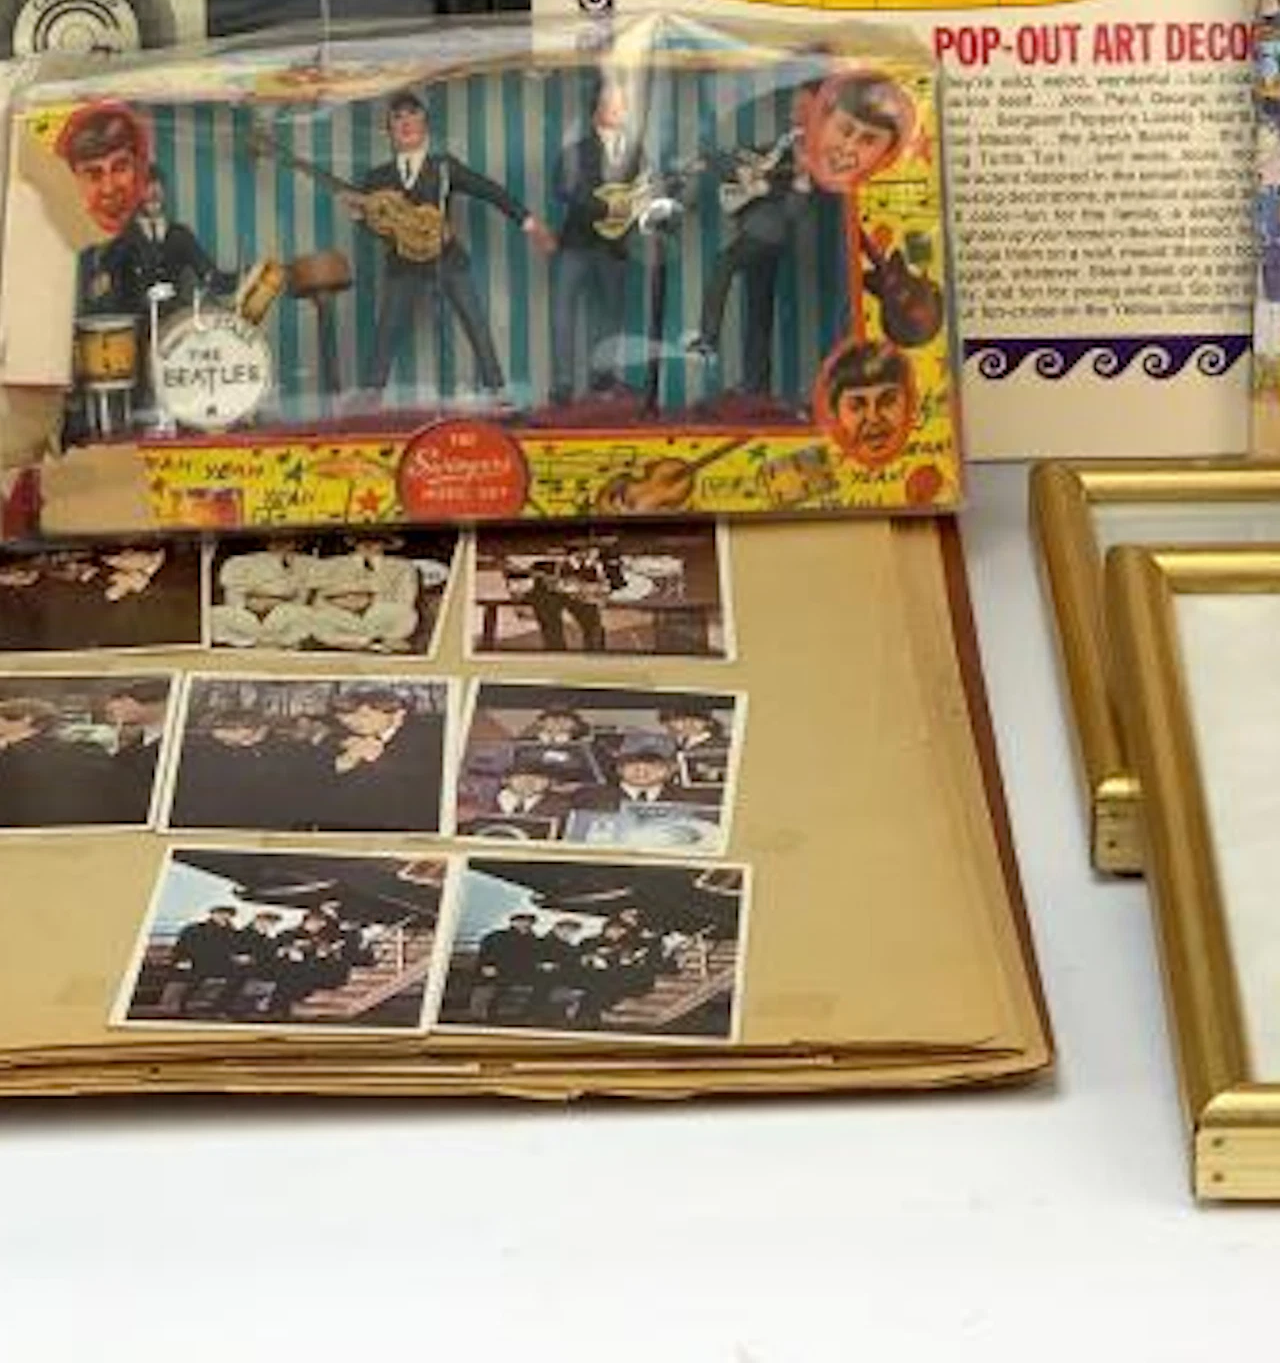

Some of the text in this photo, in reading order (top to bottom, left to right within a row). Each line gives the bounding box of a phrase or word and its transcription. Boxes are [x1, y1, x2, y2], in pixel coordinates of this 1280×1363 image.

[934, 23, 1083, 66] POP-OUT
[1092, 22, 1156, 64] ART
[163, 362, 263, 395] BEATLES
